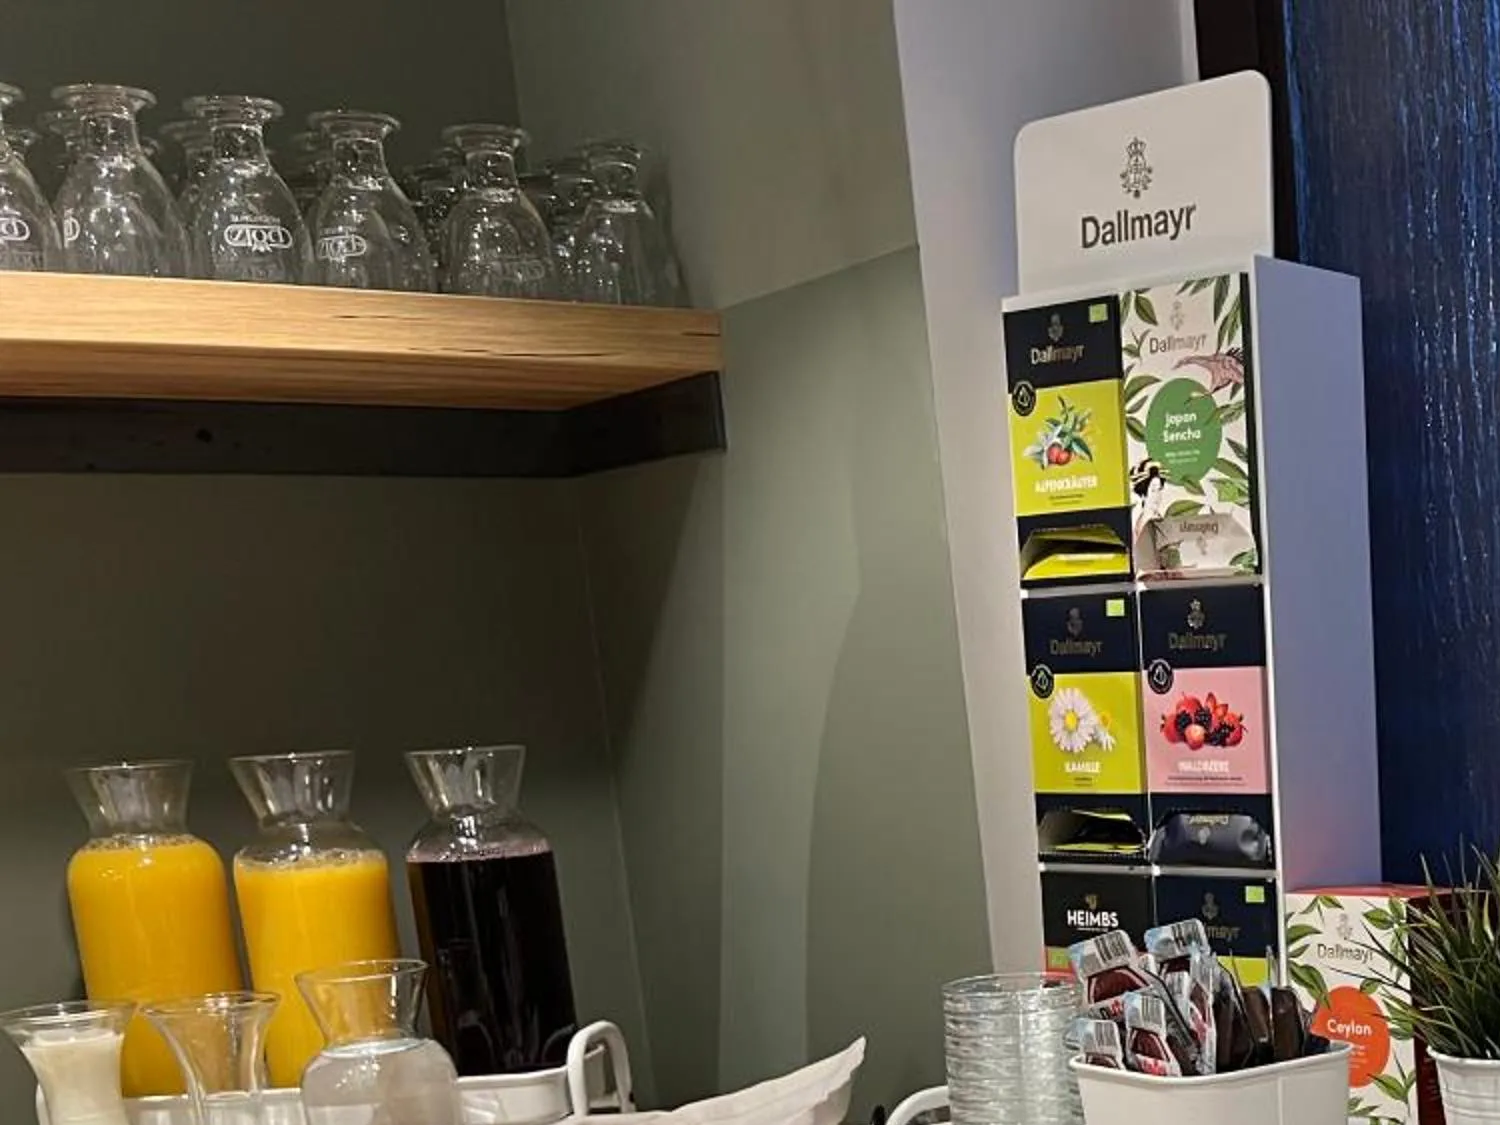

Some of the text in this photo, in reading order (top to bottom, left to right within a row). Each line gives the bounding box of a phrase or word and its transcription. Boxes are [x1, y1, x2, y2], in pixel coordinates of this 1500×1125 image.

[1081, 204, 1196, 249] Dallmayr
[1149, 333, 1207, 353] Dallmayr
[1030, 344, 1085, 366] Dallmayr
[1163, 427, 1201, 443] Sencha
[1050, 639, 1102, 657] Dallmayr
[1168, 631, 1228, 651] Dallmayr
[1067, 909, 1118, 928] HEIMBS
[1316, 943, 1374, 965] Dallmayr
[1327, 1019, 1373, 1039] Ceylon
